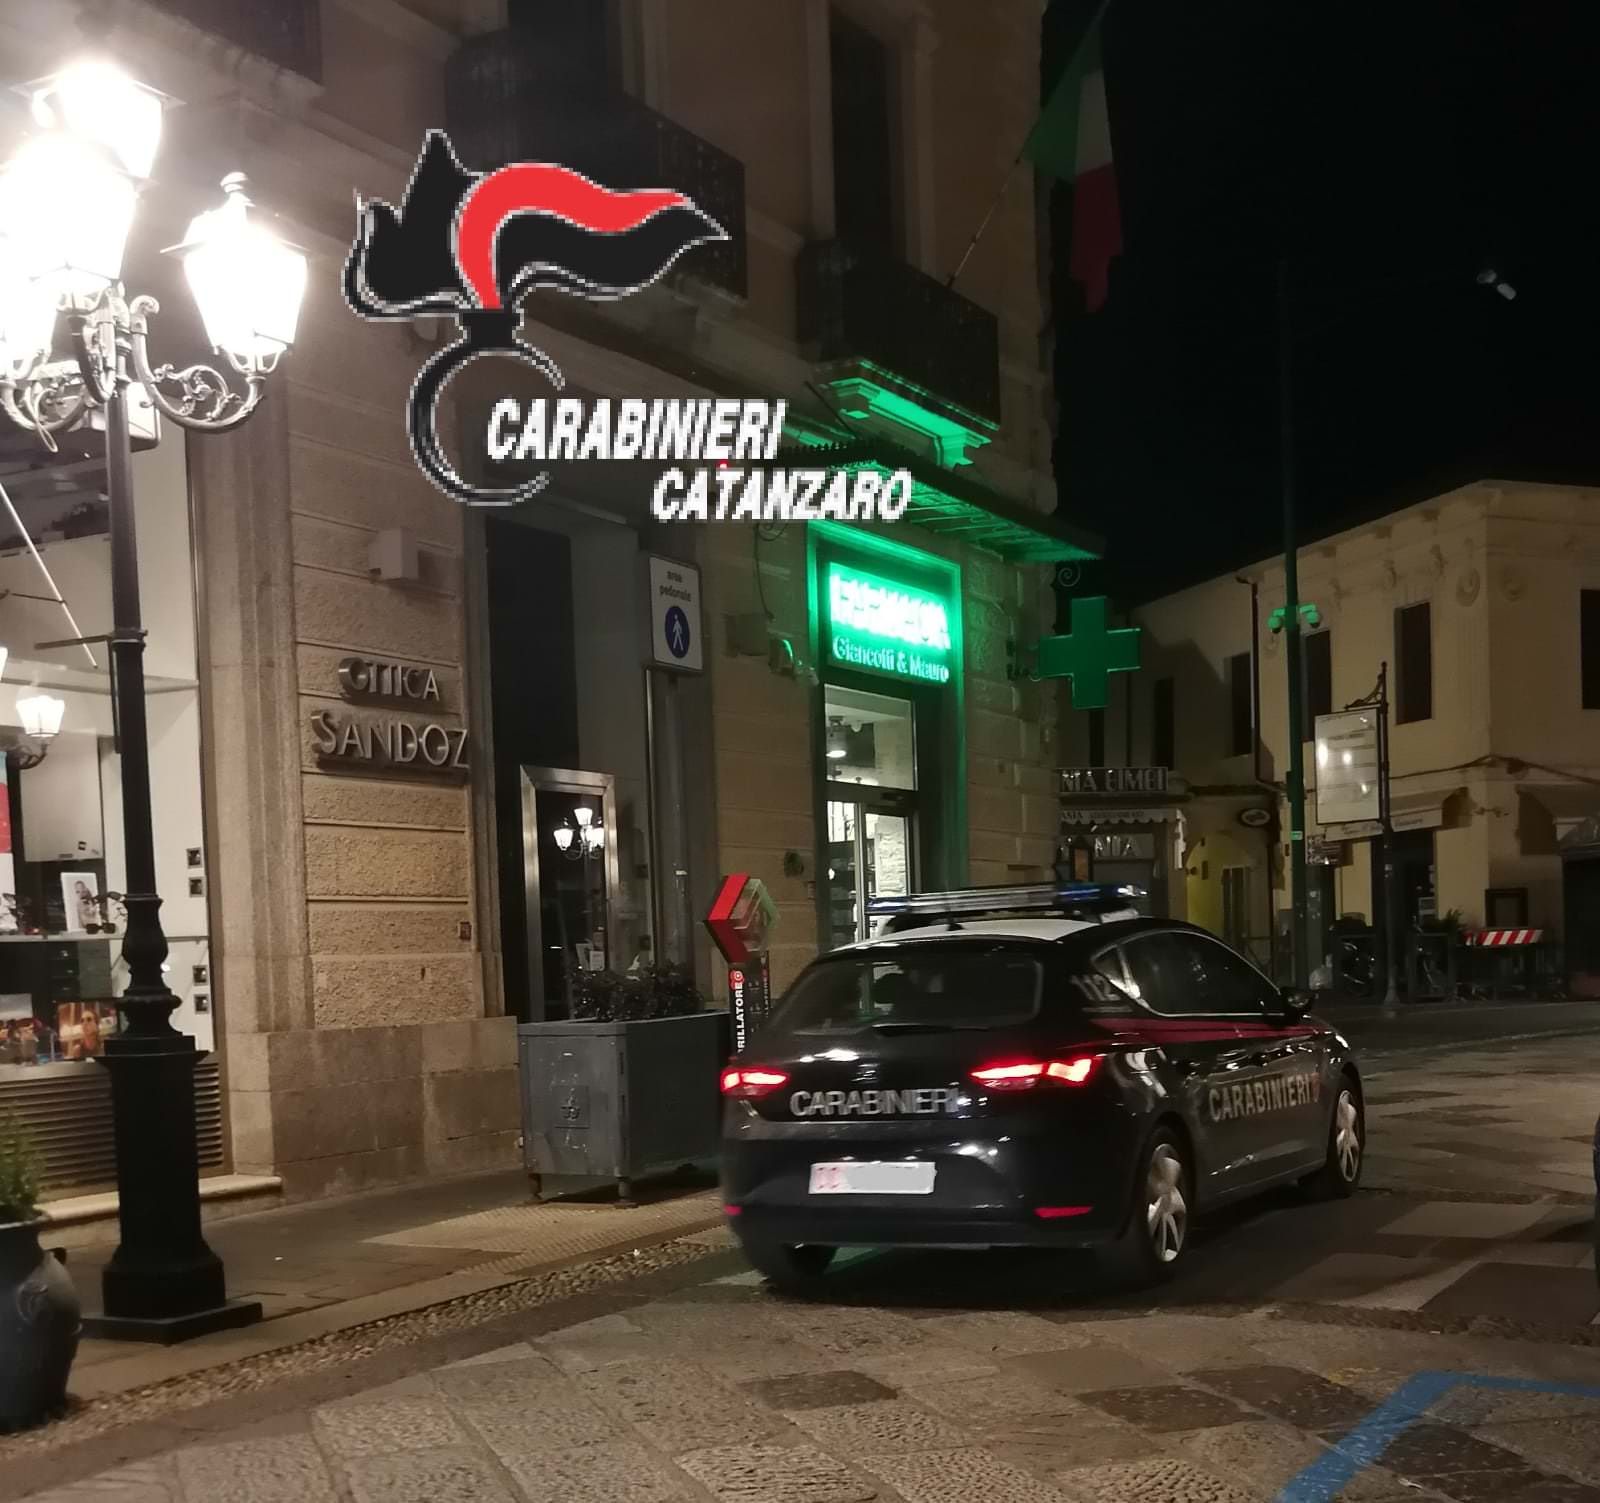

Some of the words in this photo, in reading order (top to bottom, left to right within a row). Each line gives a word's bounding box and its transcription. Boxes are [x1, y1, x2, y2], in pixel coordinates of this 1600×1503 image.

[338, 657, 440, 702] OTTICA
[896, 650, 909, 674] &
[909, 654, 950, 683] Mauro
[311, 709, 470, 769] SANDOZ
[1069, 972, 1108, 1001] 112
[789, 1087, 962, 1117] CARABINIERI
[1209, 1072, 1311, 1122] CARABINIERI
